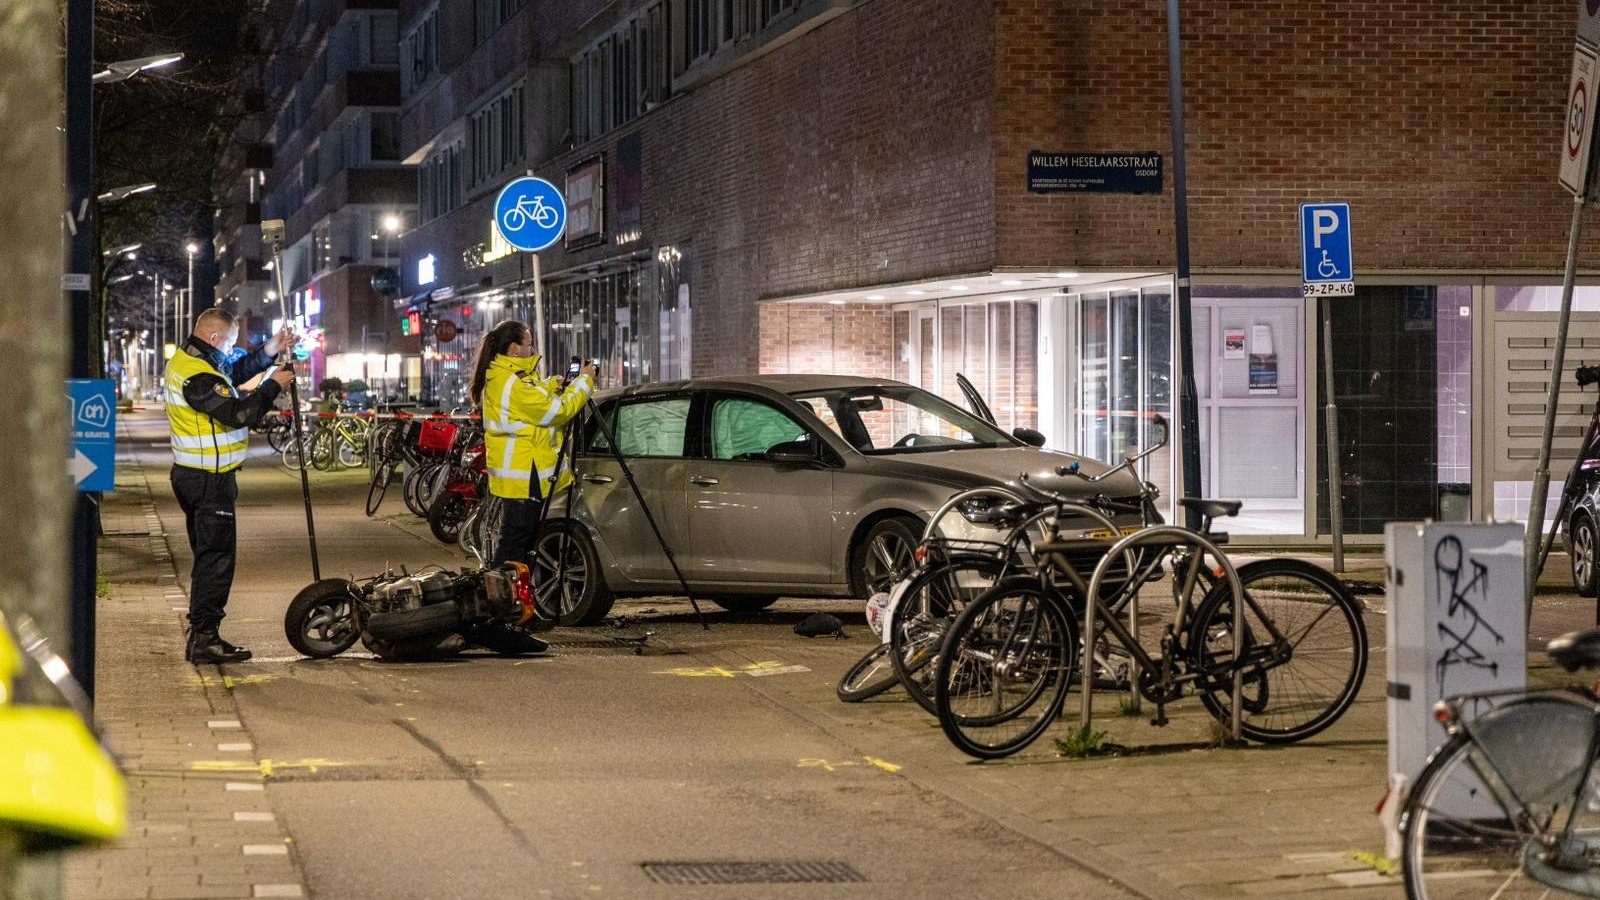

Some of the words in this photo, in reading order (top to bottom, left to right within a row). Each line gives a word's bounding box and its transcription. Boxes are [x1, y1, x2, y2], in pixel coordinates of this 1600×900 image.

[1571, 103, 1584, 136] 30
[1032, 156, 1068, 167] WILLEM
[1071, 156, 1159, 167] HESELAARSSTRAAT
[1313, 209, 1339, 248] P
[1304, 284, 1353, 295] 99-ZP-KG
